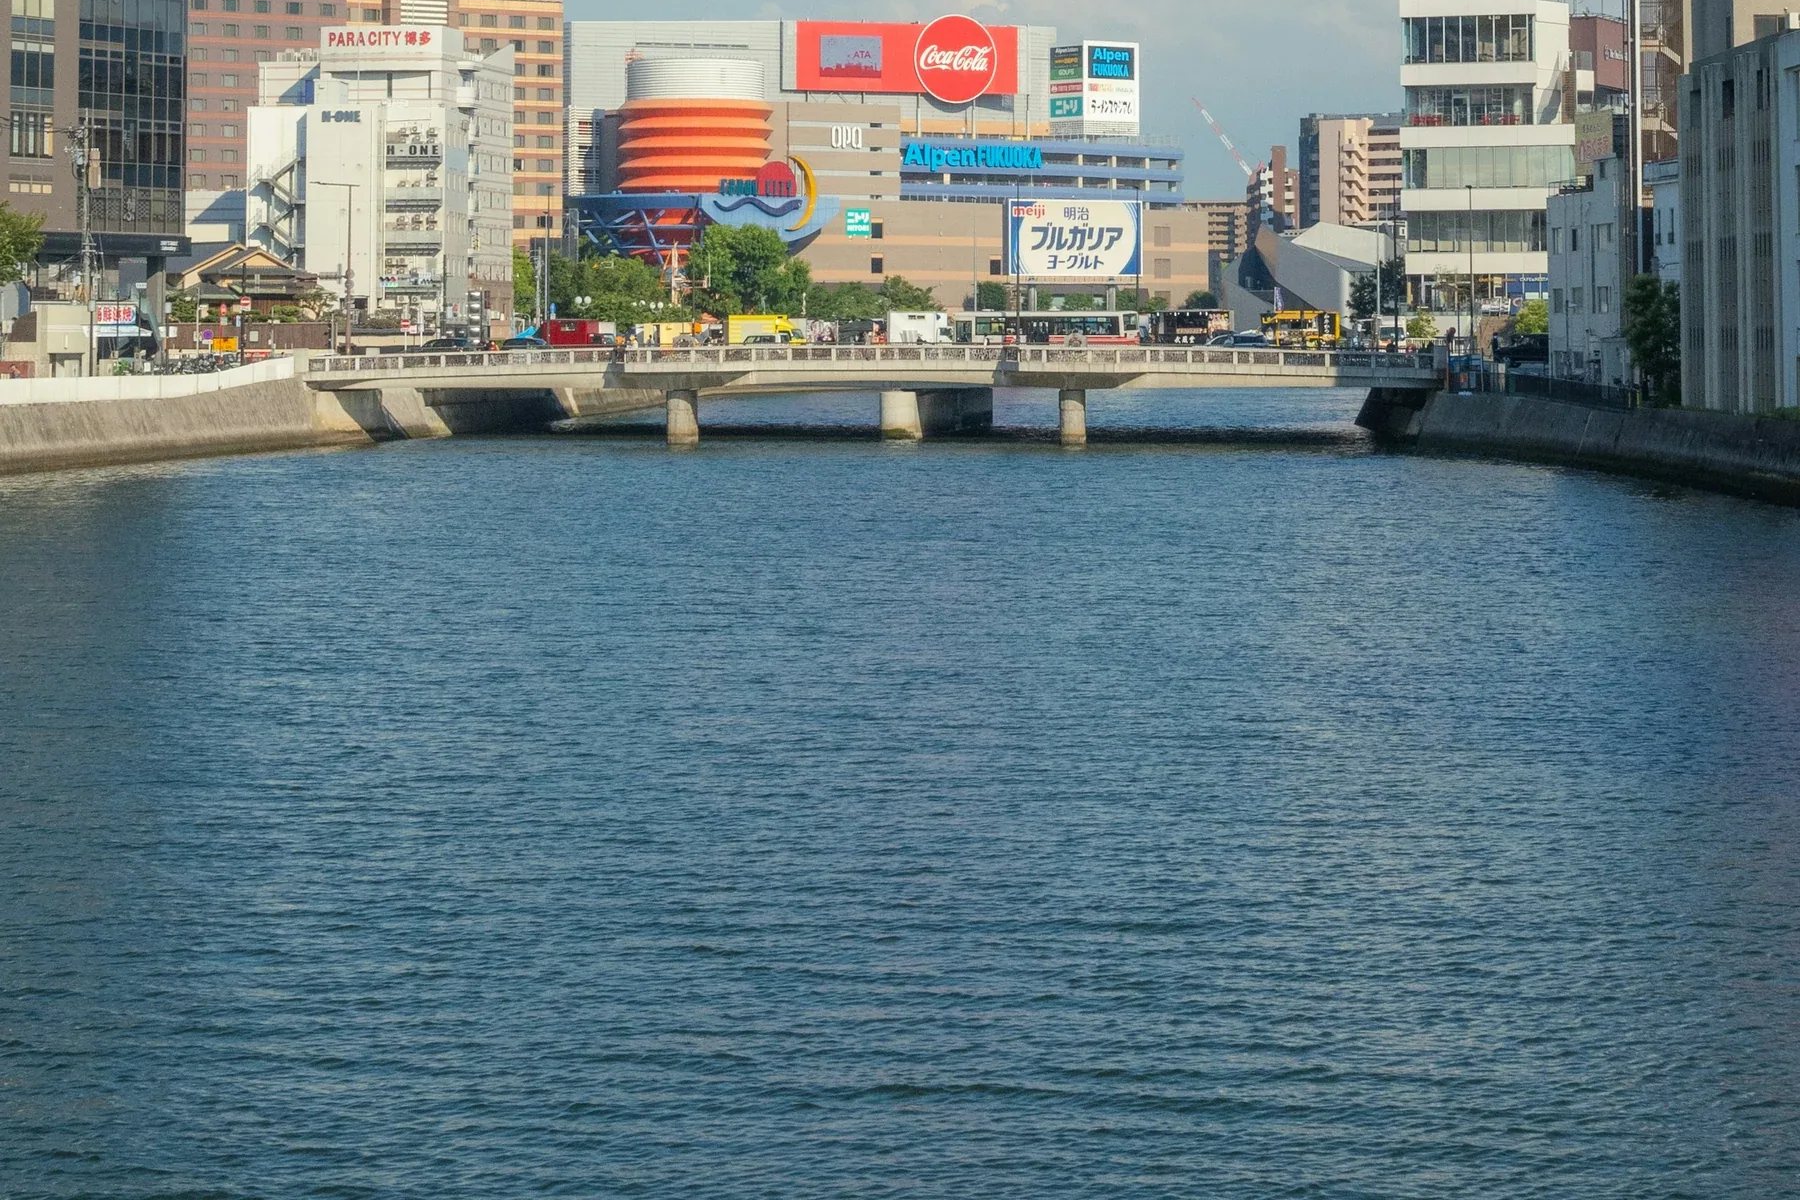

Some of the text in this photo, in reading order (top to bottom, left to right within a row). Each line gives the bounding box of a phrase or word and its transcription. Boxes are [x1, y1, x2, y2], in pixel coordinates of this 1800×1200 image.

[405, 31, 431, 46] 博多
[920, 44, 993, 72] Coca-Cola
[1092, 47, 1130, 63] Alpen
[1092, 63, 1130, 77] FUKUOKA
[1055, 100, 1078, 115] ニトリ
[321, 110, 361, 123] H-ONE
[903, 142, 1043, 172] Alpen FUKUOKA
[847, 211, 870, 224] ニトリ
[1013, 205, 1046, 219] meiji
[1063, 206, 1090, 221] 明治
[1030, 221, 1124, 252] ブルガリア
[1046, 252, 1105, 270] ヨーグルト
